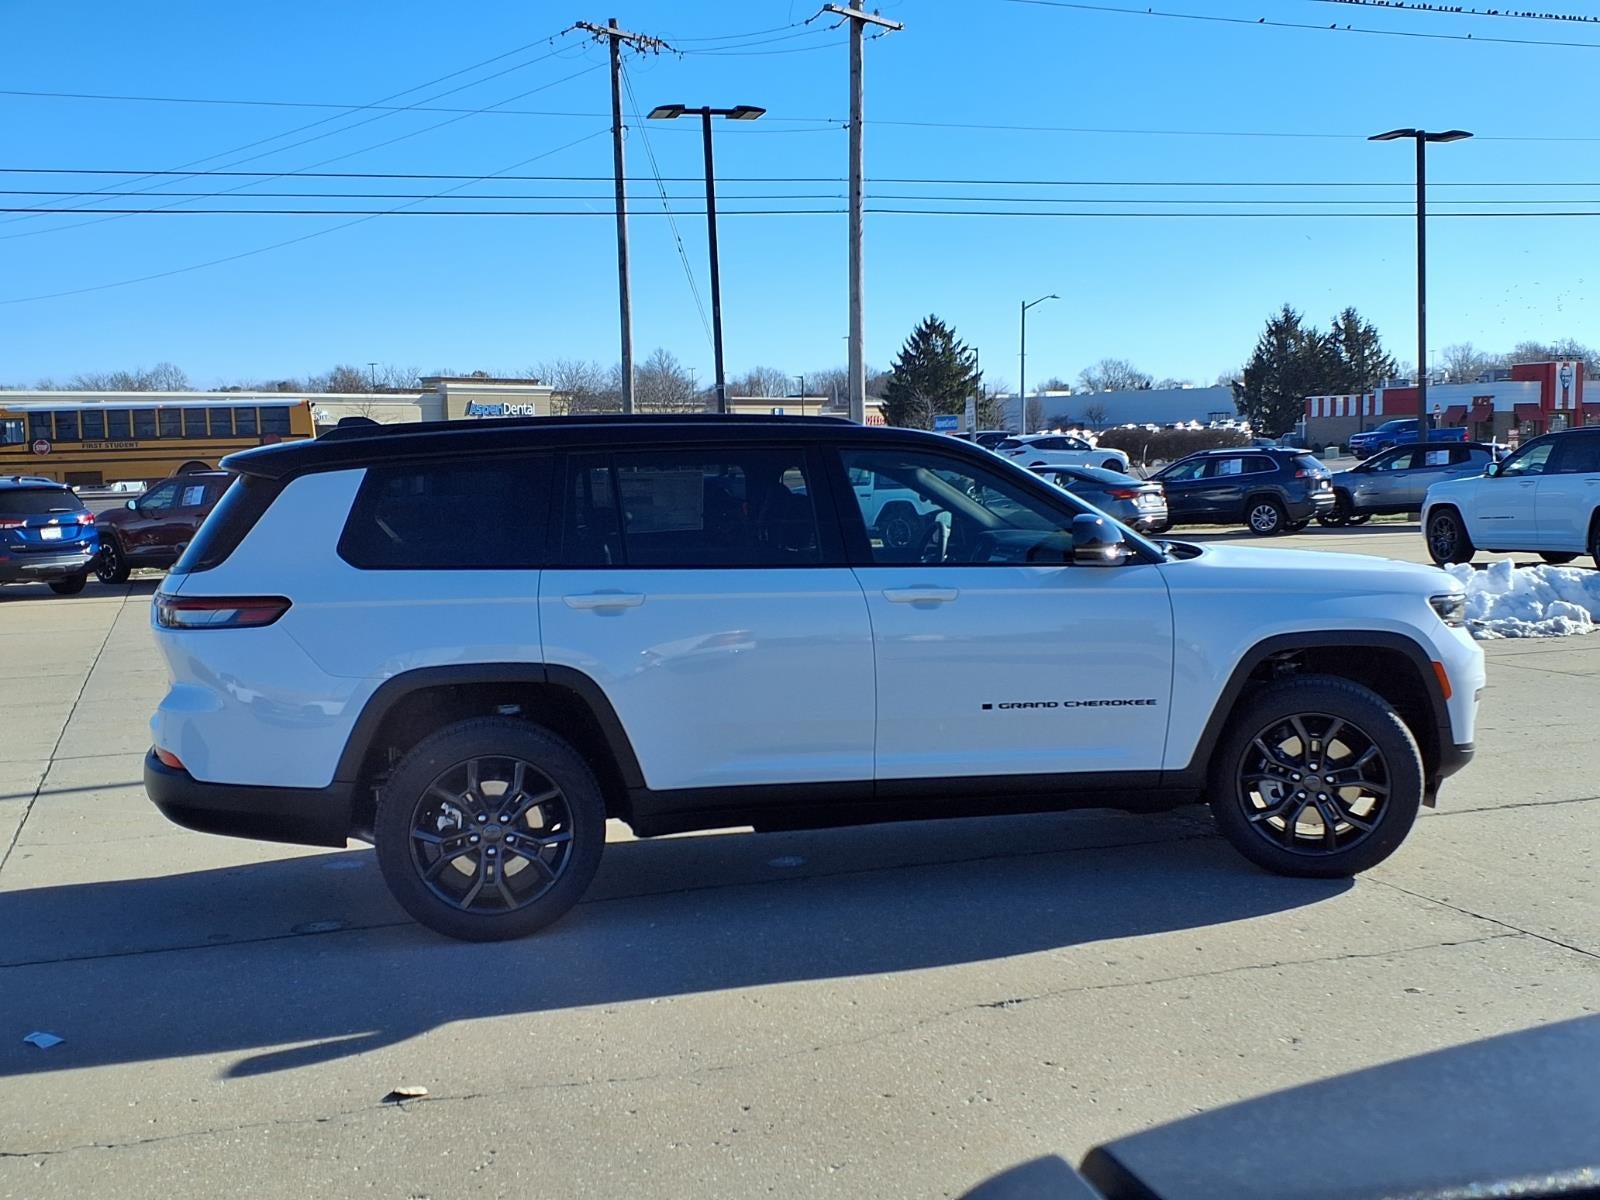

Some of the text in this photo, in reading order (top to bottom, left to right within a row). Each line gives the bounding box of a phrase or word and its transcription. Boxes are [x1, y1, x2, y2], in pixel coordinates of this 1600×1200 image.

[104, 441, 139, 449] STUDENT
[998, 698, 1158, 710] GRAND CHEROKEE
